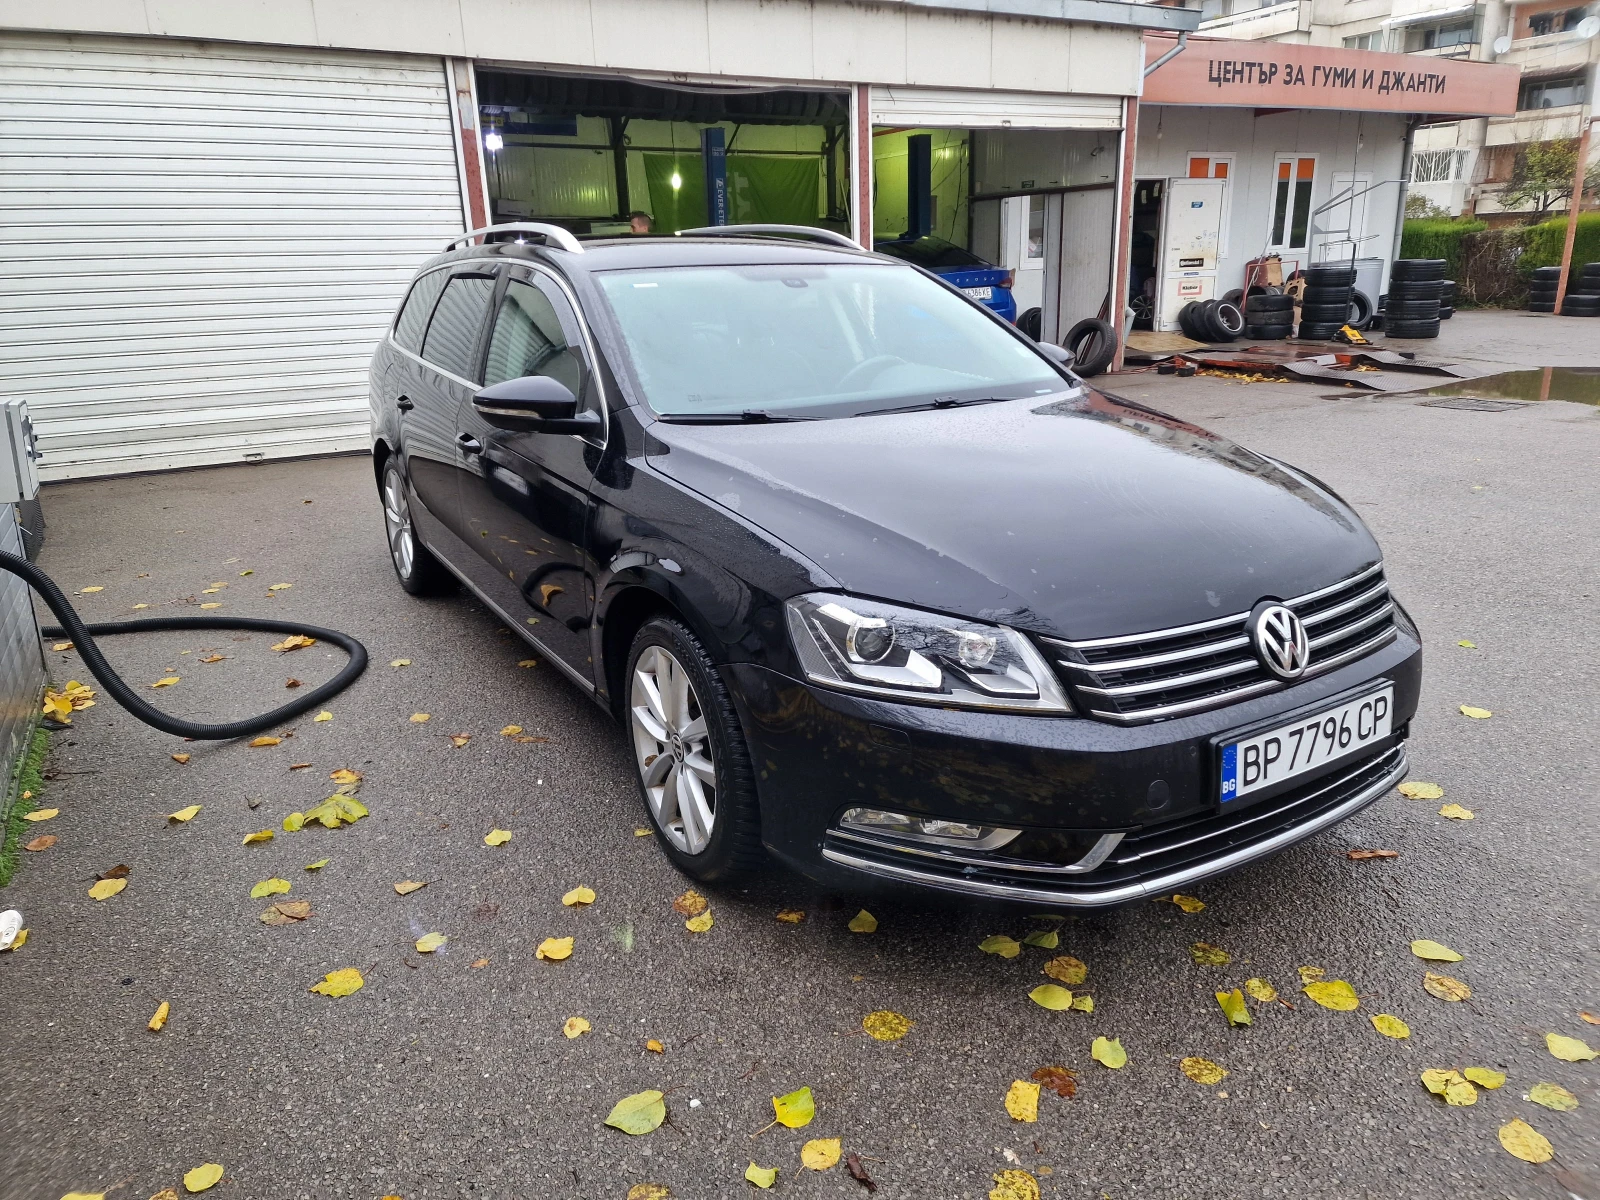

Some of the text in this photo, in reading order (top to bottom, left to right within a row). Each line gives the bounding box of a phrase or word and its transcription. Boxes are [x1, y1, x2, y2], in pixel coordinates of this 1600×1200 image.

[1208, 60, 1446, 95] ЦЕНТЪР ЗА ГУМИ И ДЖАНТИ
[1222, 781, 1236, 794] BG
